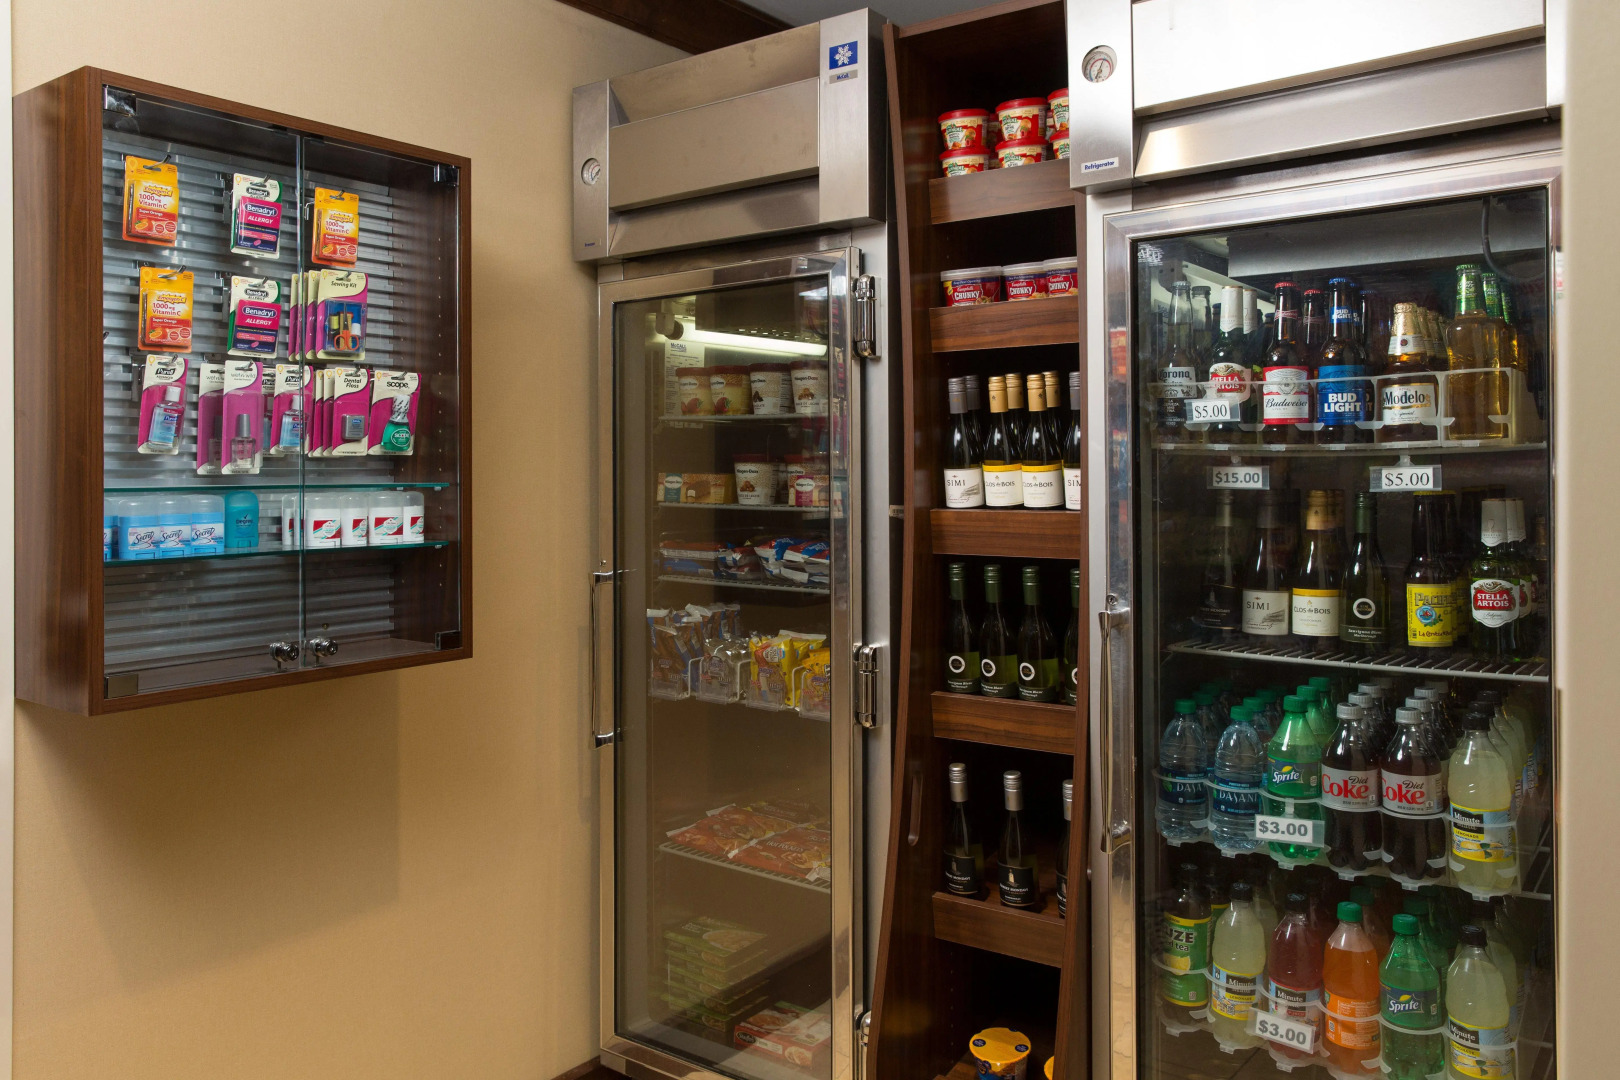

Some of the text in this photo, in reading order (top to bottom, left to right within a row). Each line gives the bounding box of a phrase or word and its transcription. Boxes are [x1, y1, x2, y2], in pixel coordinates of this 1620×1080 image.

[1084, 160, 1115, 171] Refrigerator
[138, 199, 163, 208] Vitamin
[247, 204, 276, 217] Benadryl
[247, 215, 274, 225] ALLERGY
[325, 226, 345, 234] Vitamin
[331, 280, 349, 289] Sewing
[1048, 281, 1070, 291] CHUNKY
[247, 289, 267, 297] Benadryl
[954, 290, 981, 301] CHUNKY
[1009, 286, 1033, 296] CHUNKY
[245, 307, 275, 318] Benadryl
[245, 318, 273, 326] ALLERGY
[1158, 369, 1192, 381] Corona
[1265, 397, 1308, 408] Budweiser
[1328, 393, 1357, 403] BUD
[1385, 390, 1425, 405] Modelo
[1194, 404, 1227, 419] $5.00
[1324, 402, 1362, 413] LIGHT
[946, 479, 966, 487] SIMI
[1214, 471, 1260, 484] $15.00
[1384, 472, 1430, 487] $5.00
[134, 531, 155, 544] Secret
[161, 529, 183, 542] Secret
[193, 527, 215, 540] Secret
[1246, 600, 1270, 611] SIMI
[1293, 606, 1307, 614] CLOS
[1314, 607, 1331, 615] BOIS
[1272, 770, 1300, 784] Sprite
[1348, 775, 1369, 785] Diet
[1176, 782, 1203, 793] DASA
[1322, 773, 1369, 799] Coke
[1402, 780, 1424, 790] Diet
[1219, 790, 1258, 803] DASANI
[1382, 777, 1425, 805] Coke
[1454, 811, 1480, 825] Minute
[1258, 821, 1308, 837] $3.00
[1455, 830, 1479, 839] LEMONADE
[1166, 929, 1194, 944] UZE
[1175, 942, 1189, 952] tea
[1228, 978, 1254, 987] Minute
[1277, 990, 1303, 1002] Minute
[1388, 1000, 1419, 1014] Sprite
[1258, 1019, 1306, 1045] $3.00
[1450, 1024, 1476, 1040] Minute
